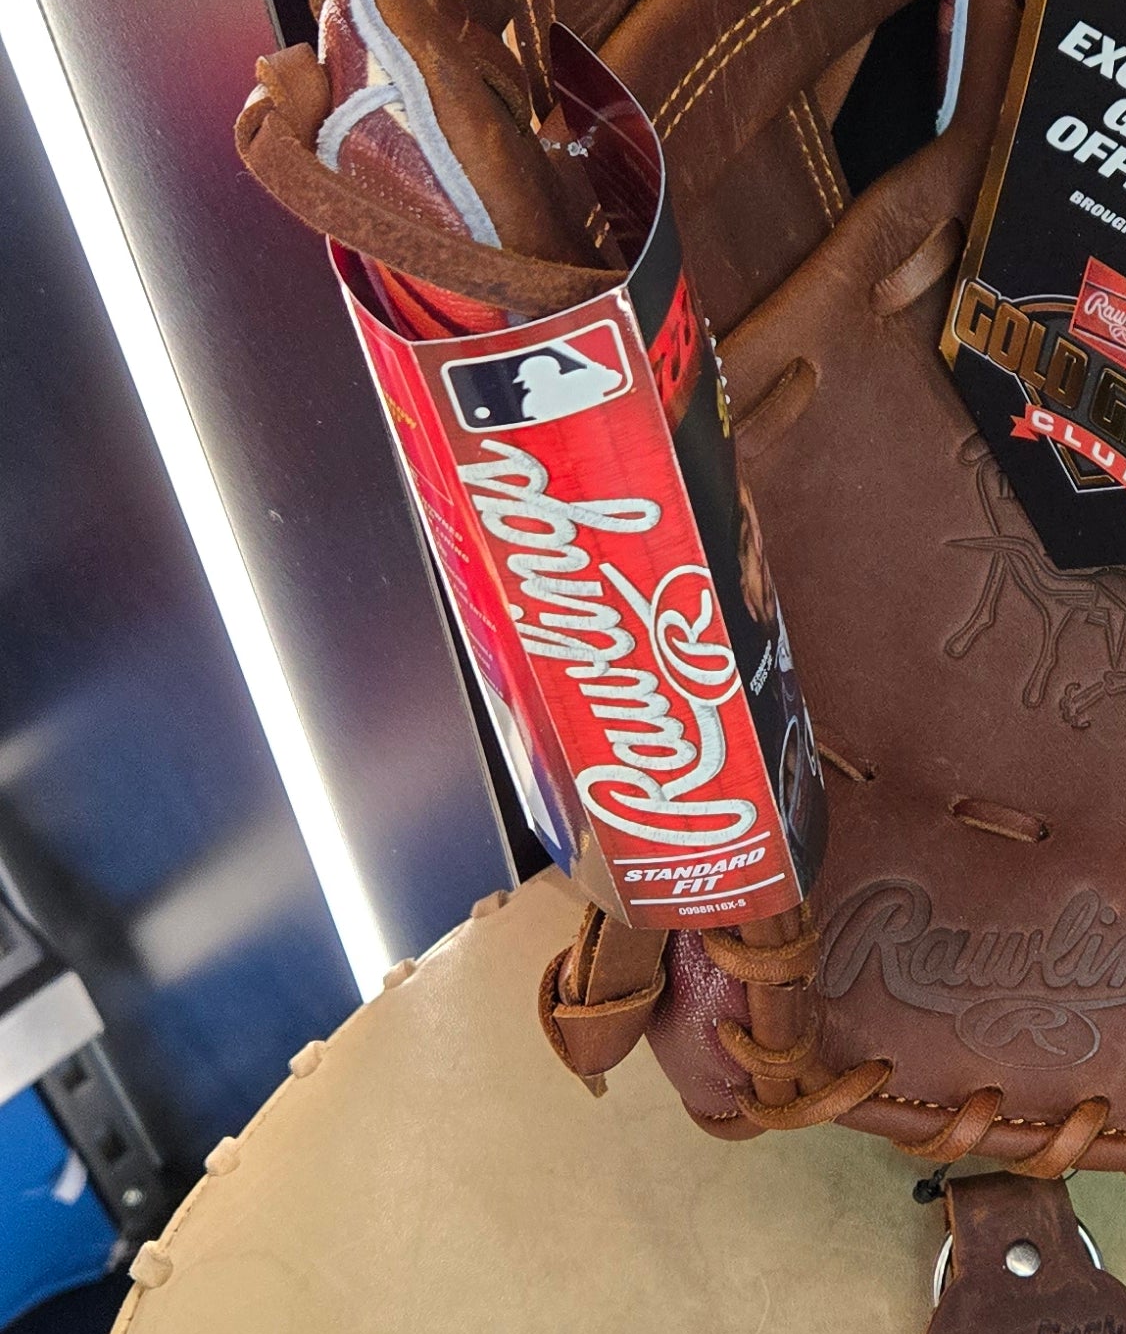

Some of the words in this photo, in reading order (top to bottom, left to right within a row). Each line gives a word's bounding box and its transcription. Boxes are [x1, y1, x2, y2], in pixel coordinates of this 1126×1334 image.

[954, 281, 1089, 410] GOLD
[458, 438, 757, 845] Rawlings
[623, 846, 766, 883] STANDARD
[671, 874, 724, 896] FIT
